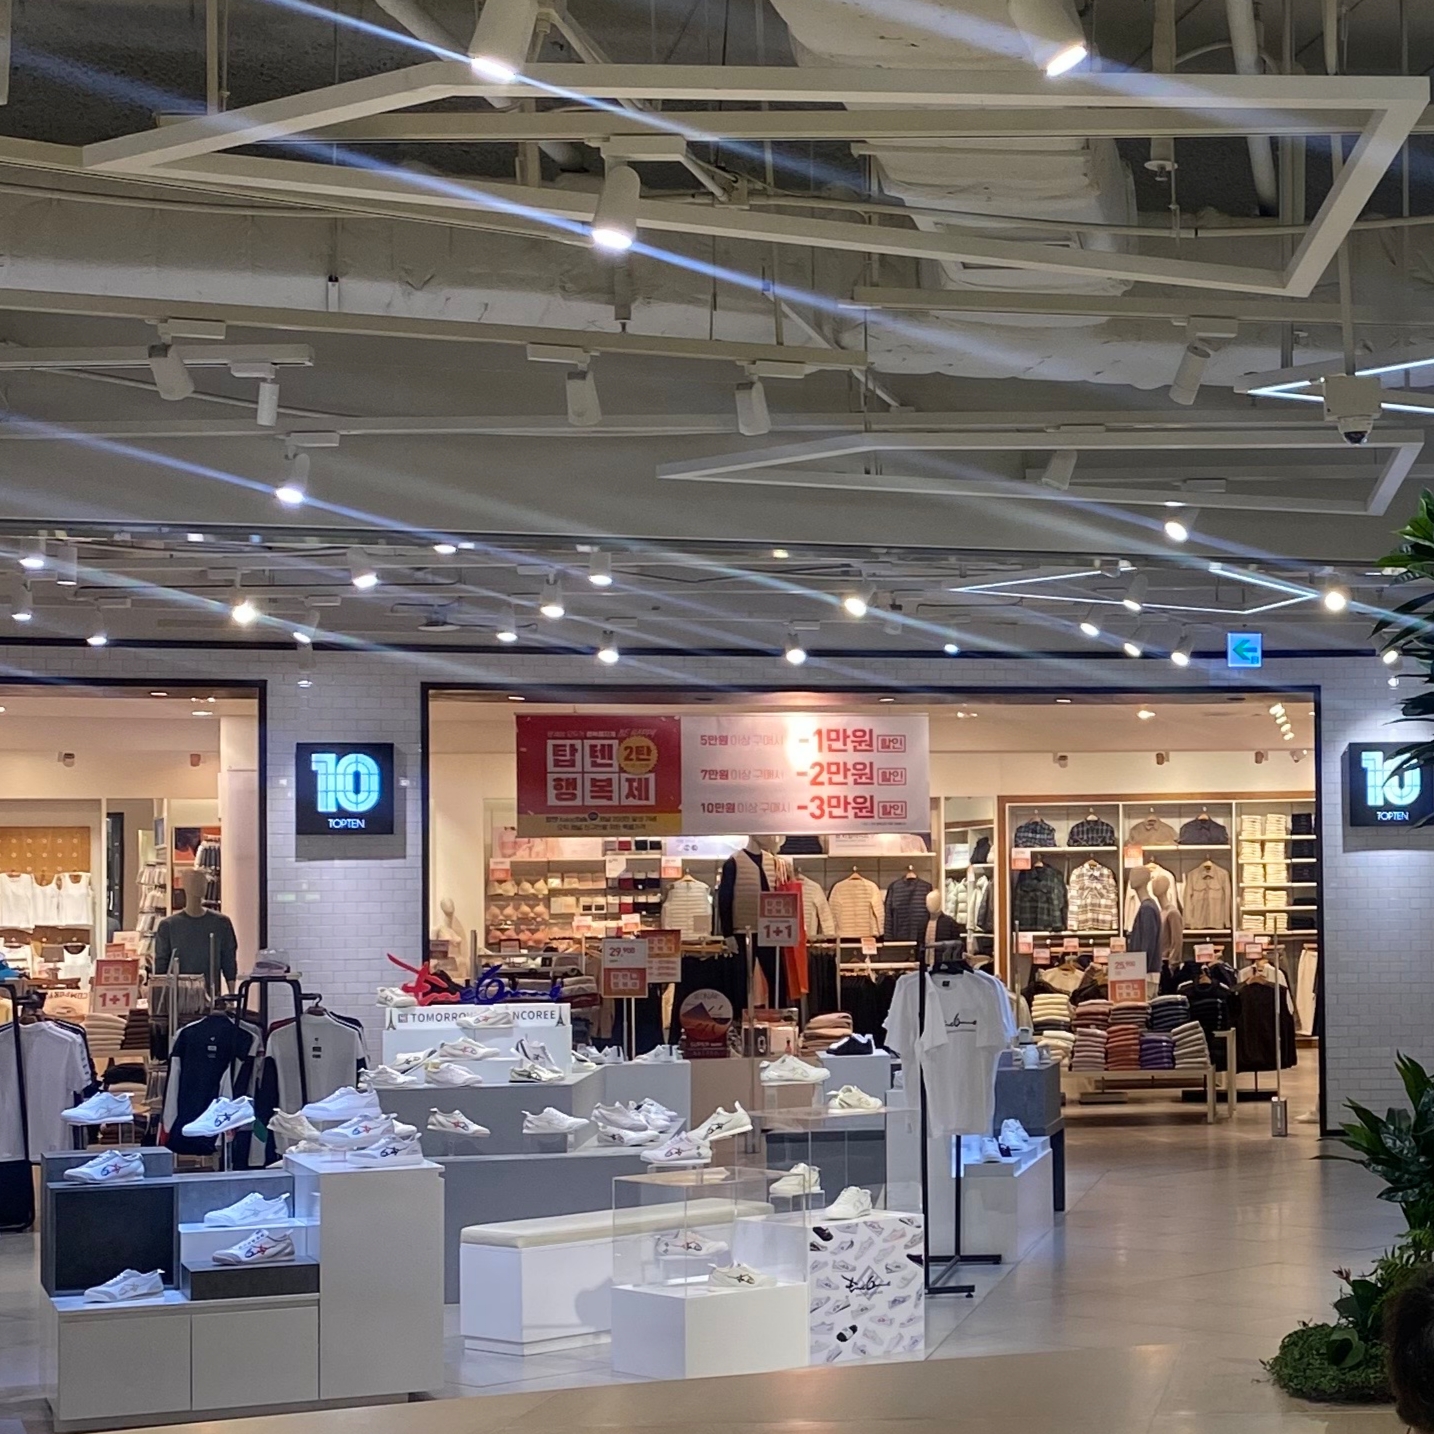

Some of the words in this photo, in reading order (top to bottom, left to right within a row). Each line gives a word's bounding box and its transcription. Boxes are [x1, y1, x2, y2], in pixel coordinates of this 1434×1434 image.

[700, 734, 728, 746] 5만원
[730, 734, 750, 746] 이상
[753, 734, 784, 746] 구매시
[880, 737, 903, 750] 할인
[551, 743, 614, 769] 탑텐
[623, 745, 652, 762] 2탄
[700, 769, 729, 781] 7만원
[731, 769, 751, 781] 이상
[754, 769, 784, 781] 구매시
[796, 761, 875, 786] -2만원
[880, 770, 904, 783] 할인
[1361, 751, 1421, 806] 10
[311, 753, 380, 812] 10
[552, 777, 650, 802] 행복제
[700, 802, 736, 814] 10만원
[737, 802, 758, 814] 이상
[759, 802, 791, 814] 구매시
[797, 794, 875, 819] -3만원
[881, 803, 905, 817] 할인
[327, 818, 366, 829] TOPTEN
[1376, 811, 1410, 821] TOPTEN
[763, 924, 793, 939] 1+1
[98, 992, 131, 1007] 1+1
[513, 1010, 557, 1021] NCOREE
